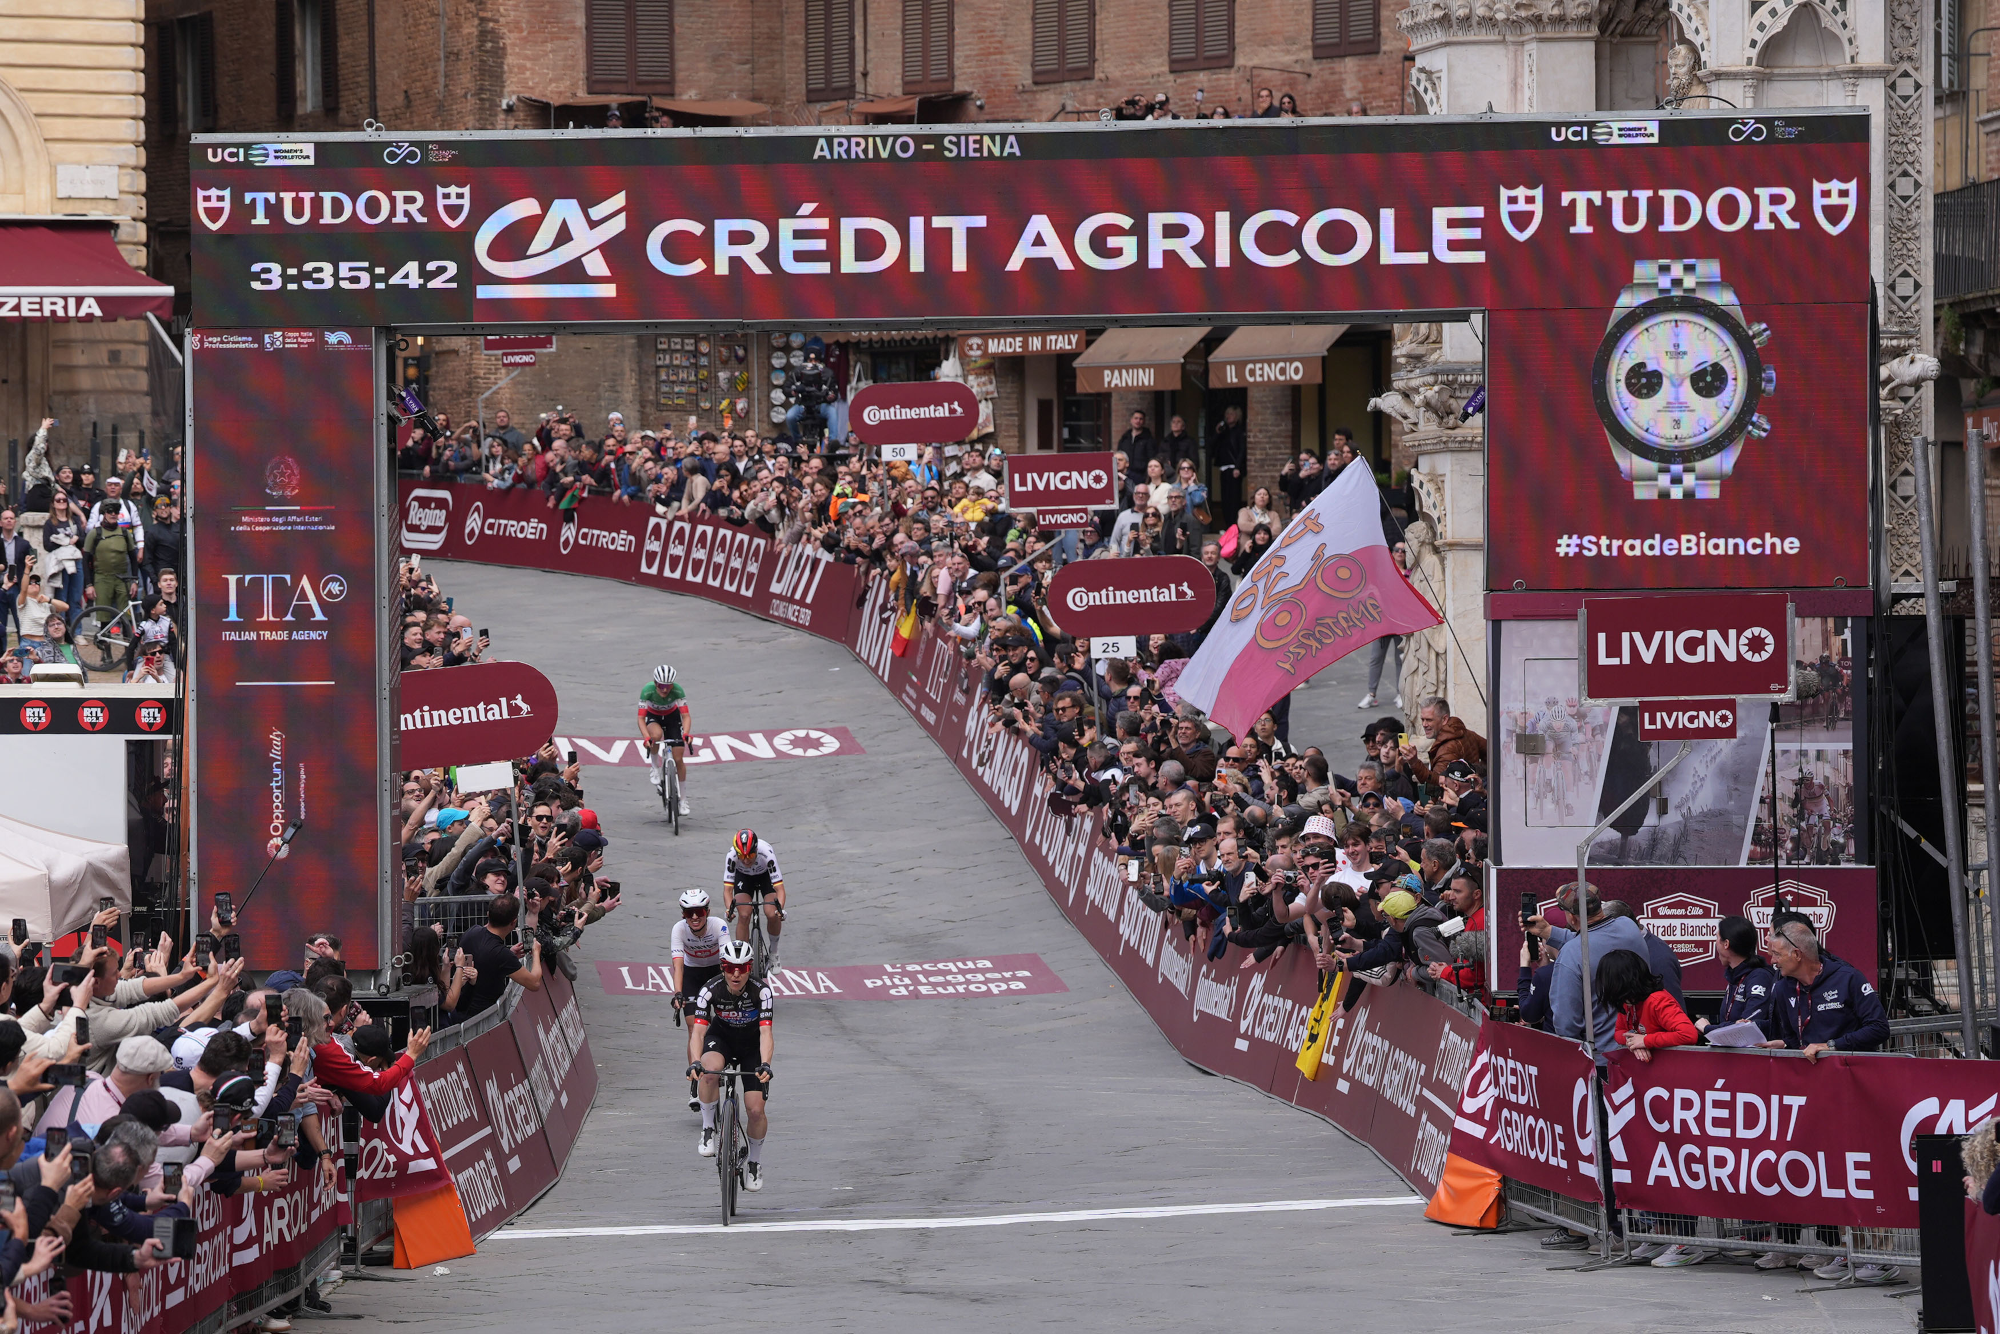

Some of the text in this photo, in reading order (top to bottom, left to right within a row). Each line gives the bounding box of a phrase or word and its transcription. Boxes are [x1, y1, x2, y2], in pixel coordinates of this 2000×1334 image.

[1551, 126, 1588, 142] UCI
[207, 148, 244, 162] UCI
[813, 135, 915, 160] ARRIVO
[943, 134, 1021, 158] SIENA
[244, 189, 428, 226] TUDOR
[1561, 186, 1800, 234] TUDOR
[646, 202, 1487, 277] CRÉDIT AGRICOLE
[250, 260, 458, 291] 3:35:42
[0, 297, 103, 318] ZERIA
[204, 334, 252, 343] Lega Ciclismo
[988, 336, 1022, 354] MADE
[1028, 335, 1042, 352] IN
[1045, 333, 1078, 351] ITALY
[503, 354, 536, 364] LIVIGNO
[1103, 367, 1155, 388] PANINI
[1226, 361, 1304, 384] IL CENCIO
[405, 396, 420, 414] LYNX
[862, 402, 950, 425] Continental
[891, 447, 906, 458] 50
[1014, 469, 1109, 492] LIVIGNO
[241, 515, 270, 523] Ministero
[271, 515, 286, 523] degli
[407, 500, 447, 531] Regina
[1039, 511, 1088, 526] LIVIGNO
[251, 524, 292, 532] Cooperazione
[1555, 532, 1801, 557] #StradeBianche
[221, 574, 328, 622] ITA
[1066, 583, 1177, 613] Continental
[222, 630, 328, 641] ITALIAN TRADE AGENCY
[1597, 626, 1775, 666] LIVIGNO
[1101, 642, 1121, 654] 25
[25, 707, 46, 717] RTL
[25, 715, 46, 723] 102.5
[83, 707, 104, 717] RTL
[83, 715, 104, 723] 102.5
[140, 707, 161, 717] RTL
[400, 697, 510, 731] ntinental
[1644, 709, 1734, 730] LIVIGNO
[269, 727, 285, 836] OpportunItaly
[1657, 906, 1704, 916] Women Elite
[1646, 921, 1717, 937] Strade Bianche
[883, 957, 994, 973] L'acqua
[864, 967, 1033, 988] più leggera
[889, 979, 1027, 997] d'Europa
[1254, 984, 1293, 1045] CRÉDIT
[1283, 1003, 1345, 1066] AGRLE
[1355, 1022, 1390, 1091] CRÉDIT
[1380, 1045, 1427, 1118] AGRICOLE
[1490, 1048, 1540, 1109] CRÉDIT
[503, 1072, 543, 1145] CRÉDIT
[1642, 1078, 1807, 1141] CRÉDIT
[1489, 1107, 1568, 1169] AGRICOLE
[1646, 1141, 1874, 1200] AGRICOLE
[187, 1225, 231, 1299] AGRICOLE
